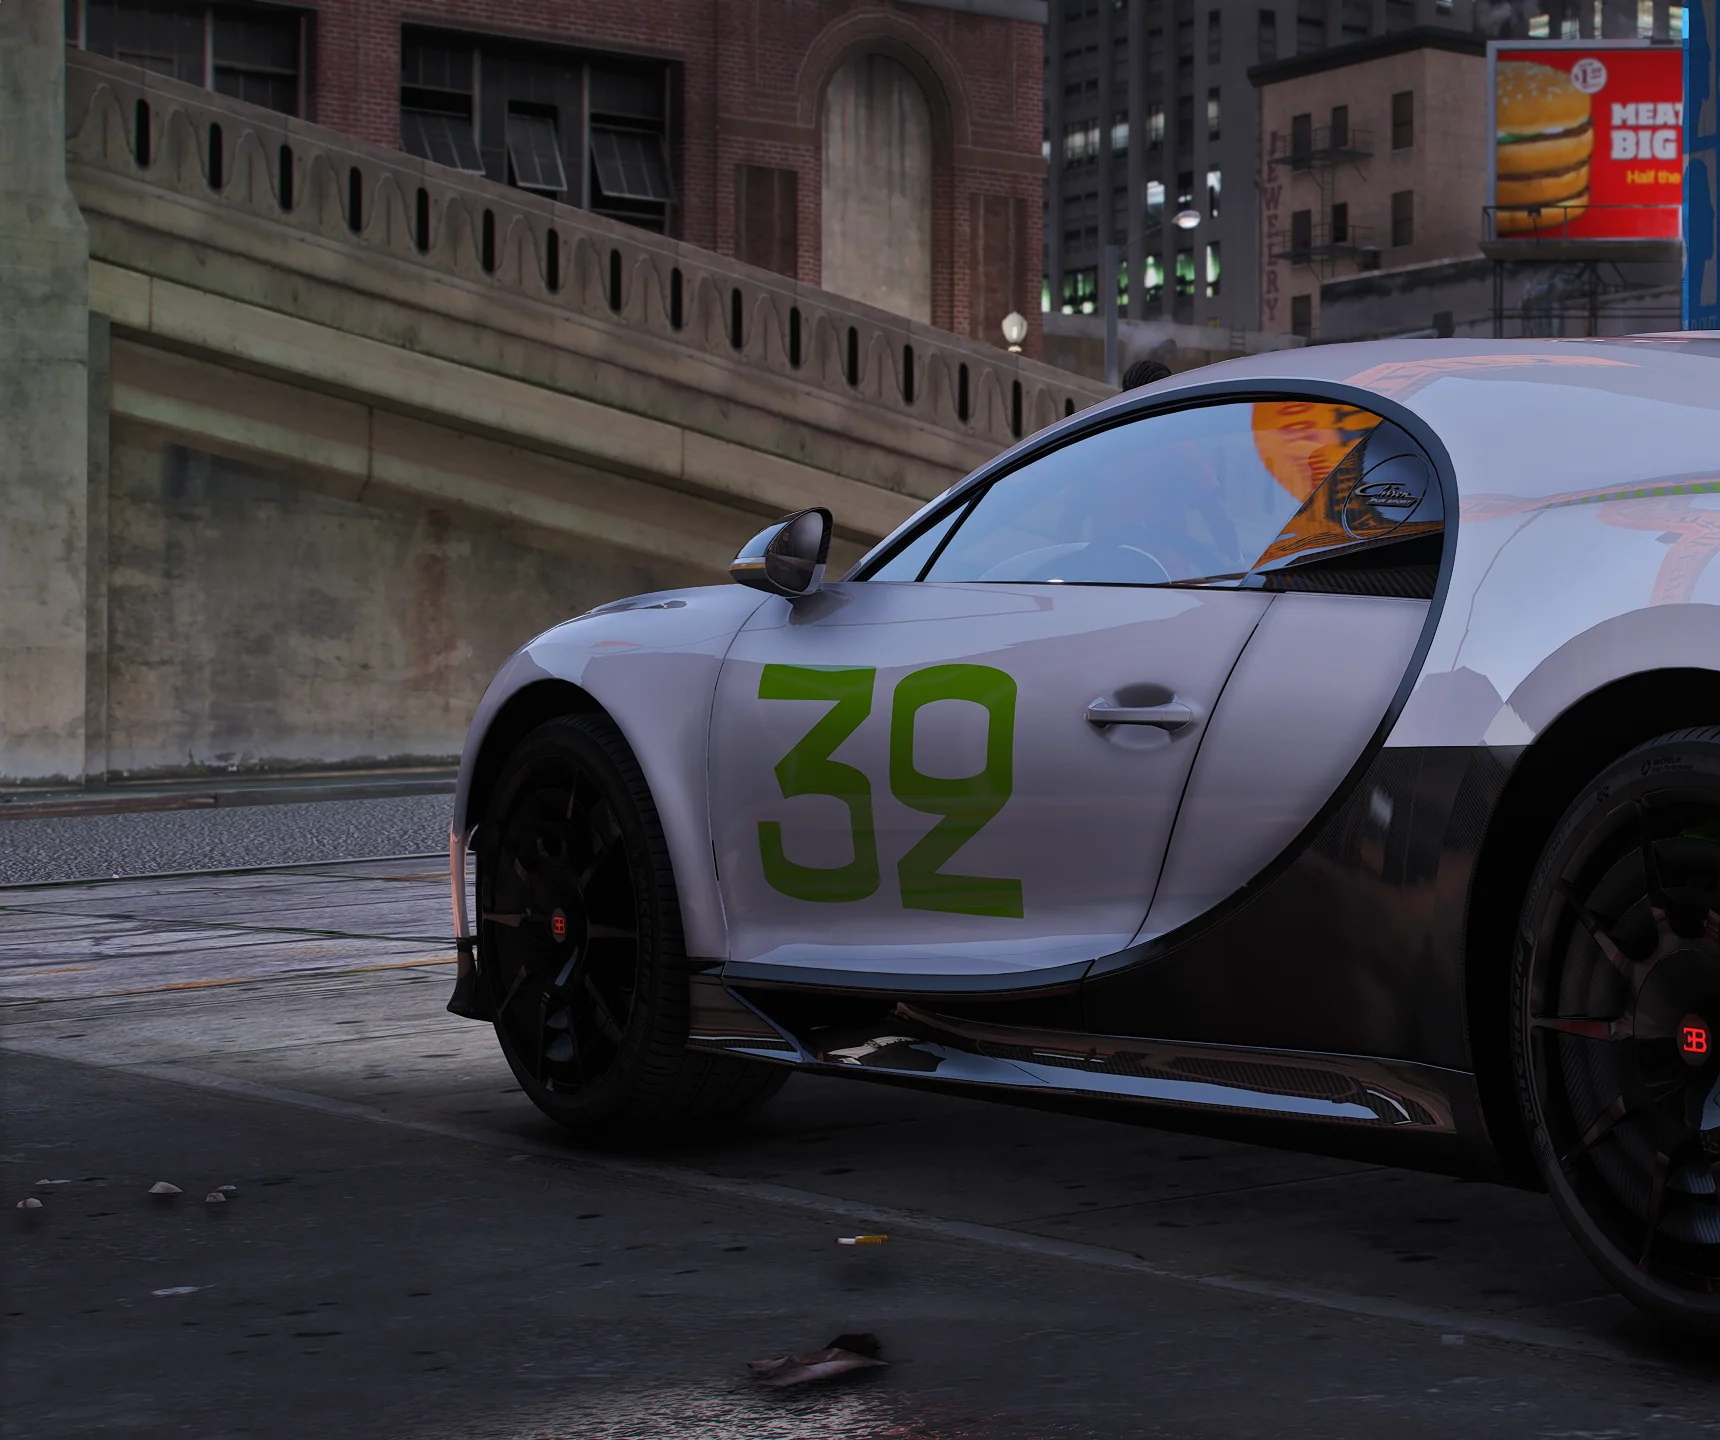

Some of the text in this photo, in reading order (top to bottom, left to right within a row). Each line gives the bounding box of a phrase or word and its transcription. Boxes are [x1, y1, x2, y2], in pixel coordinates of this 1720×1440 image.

[1610, 129, 1677, 160] BIG
[1627, 169, 1681, 184] Half the
[1355, 481, 1418, 499] Chiron
[758, 664, 1024, 919] 32
